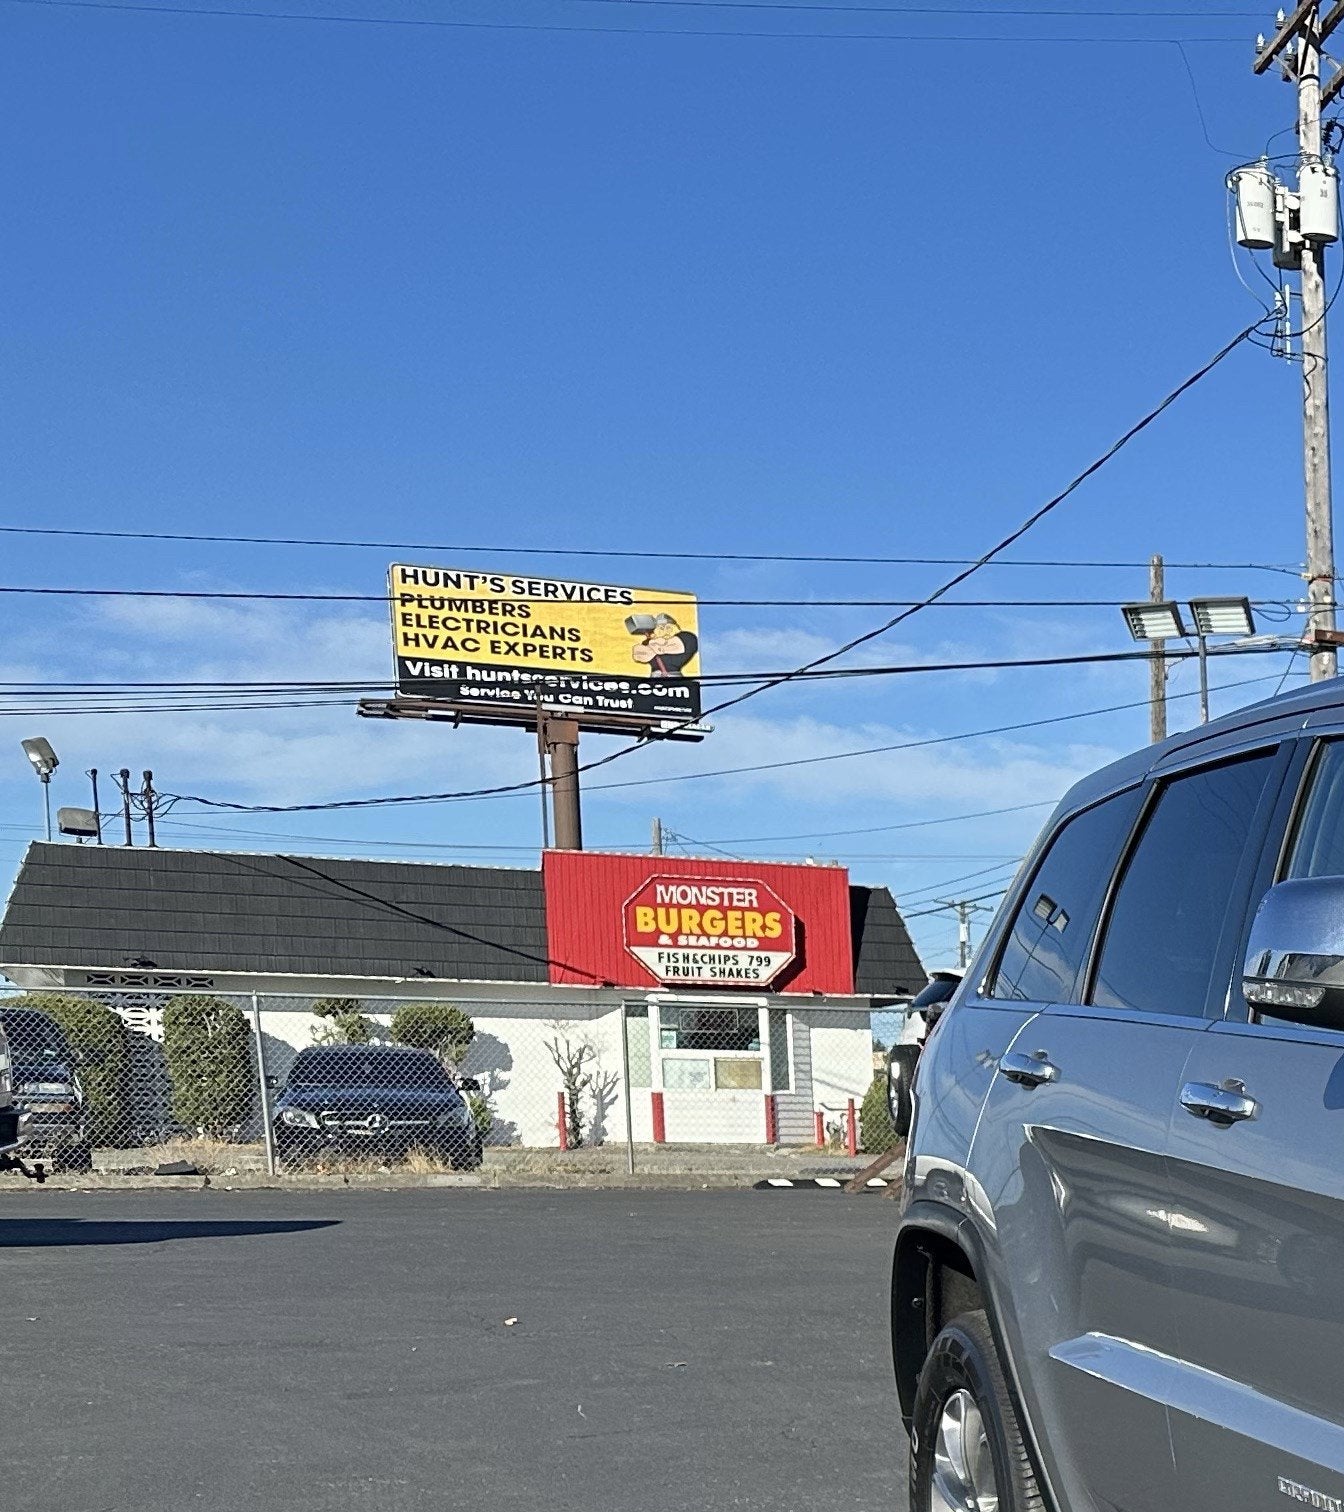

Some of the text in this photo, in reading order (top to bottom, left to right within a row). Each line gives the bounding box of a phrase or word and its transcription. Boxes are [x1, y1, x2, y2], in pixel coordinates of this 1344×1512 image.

[400, 568, 633, 606] HUNT'S SERVICES
[400, 592, 531, 619] PLUMBERS
[401, 612, 581, 643] ELECTRICIANS
[402, 632, 594, 663] HVAC EXPERTS
[405, 660, 460, 680] Visit
[558, 693, 593, 706] Can
[595, 695, 634, 709] Trust
[656, 884, 759, 907] MONSTER
[635, 906, 782, 938] BURGERS
[658, 934, 759, 949] & SEAFOOD
[657, 952, 771, 967] FISH&CHIPS 799
[665, 965, 760, 979] FRUIT SHAKES
